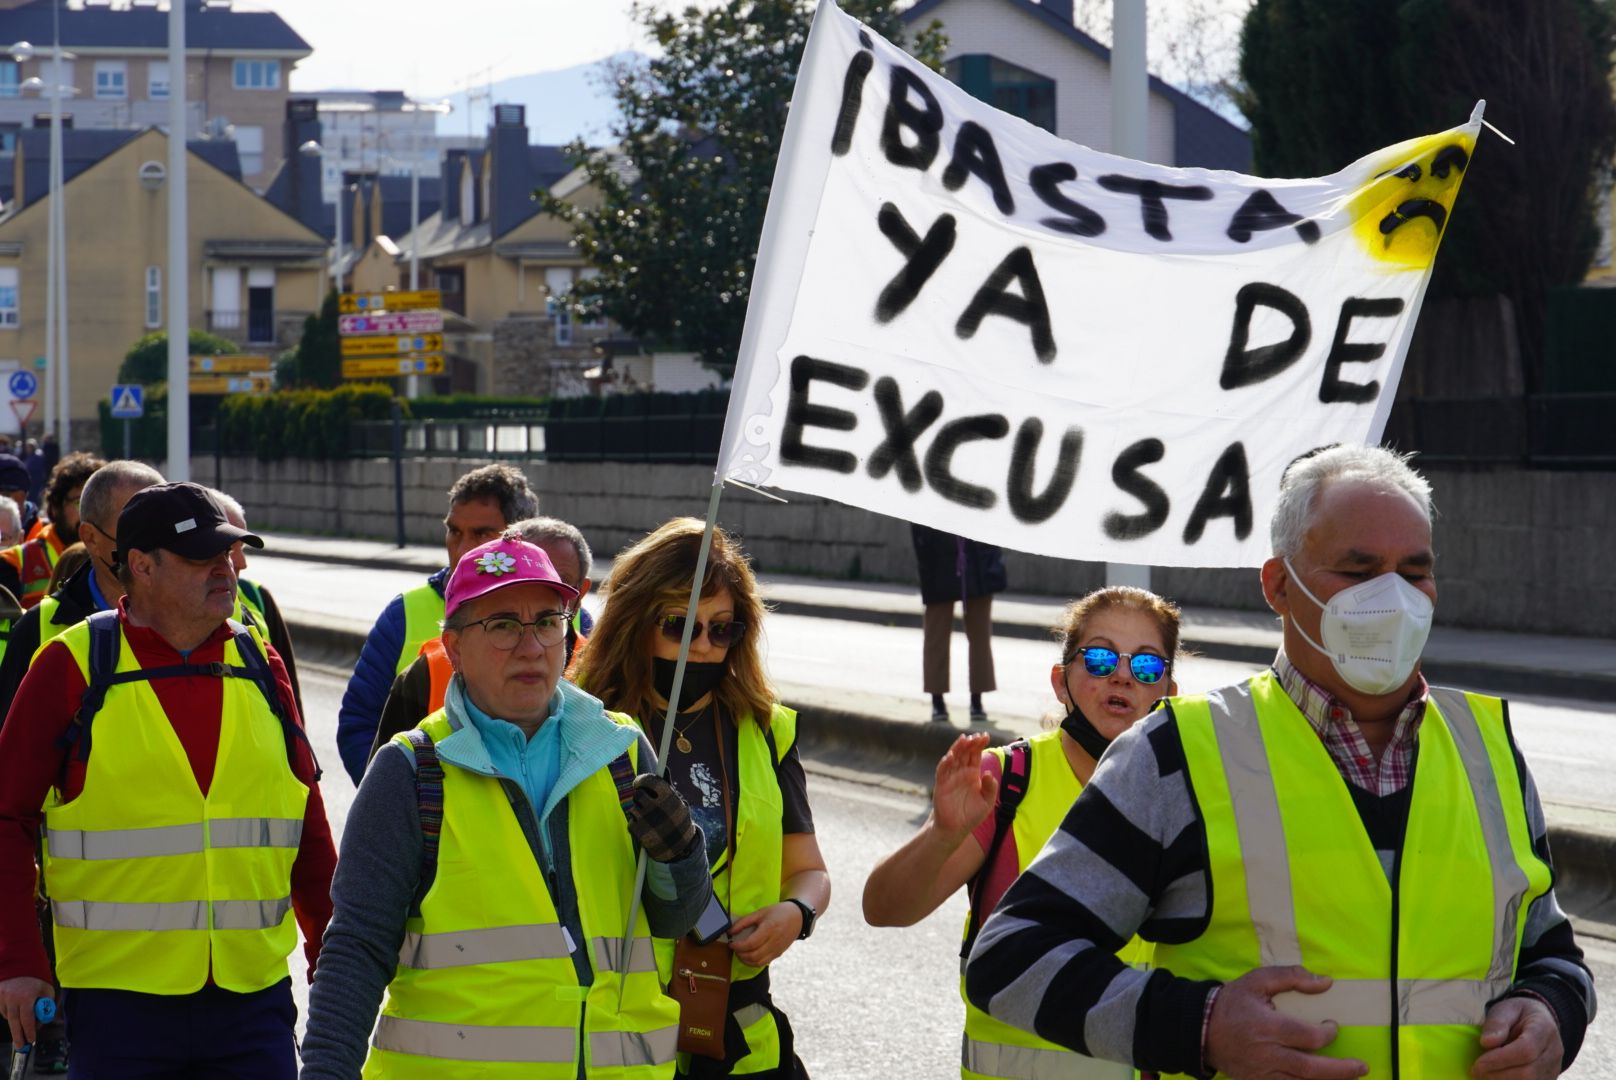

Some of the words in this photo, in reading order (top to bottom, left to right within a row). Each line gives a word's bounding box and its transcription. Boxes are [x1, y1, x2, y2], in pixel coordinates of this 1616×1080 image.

[873, 201, 1057, 364] YA
[1218, 281, 1407, 405] DE
[778, 354, 1335, 547] EXCUSA
